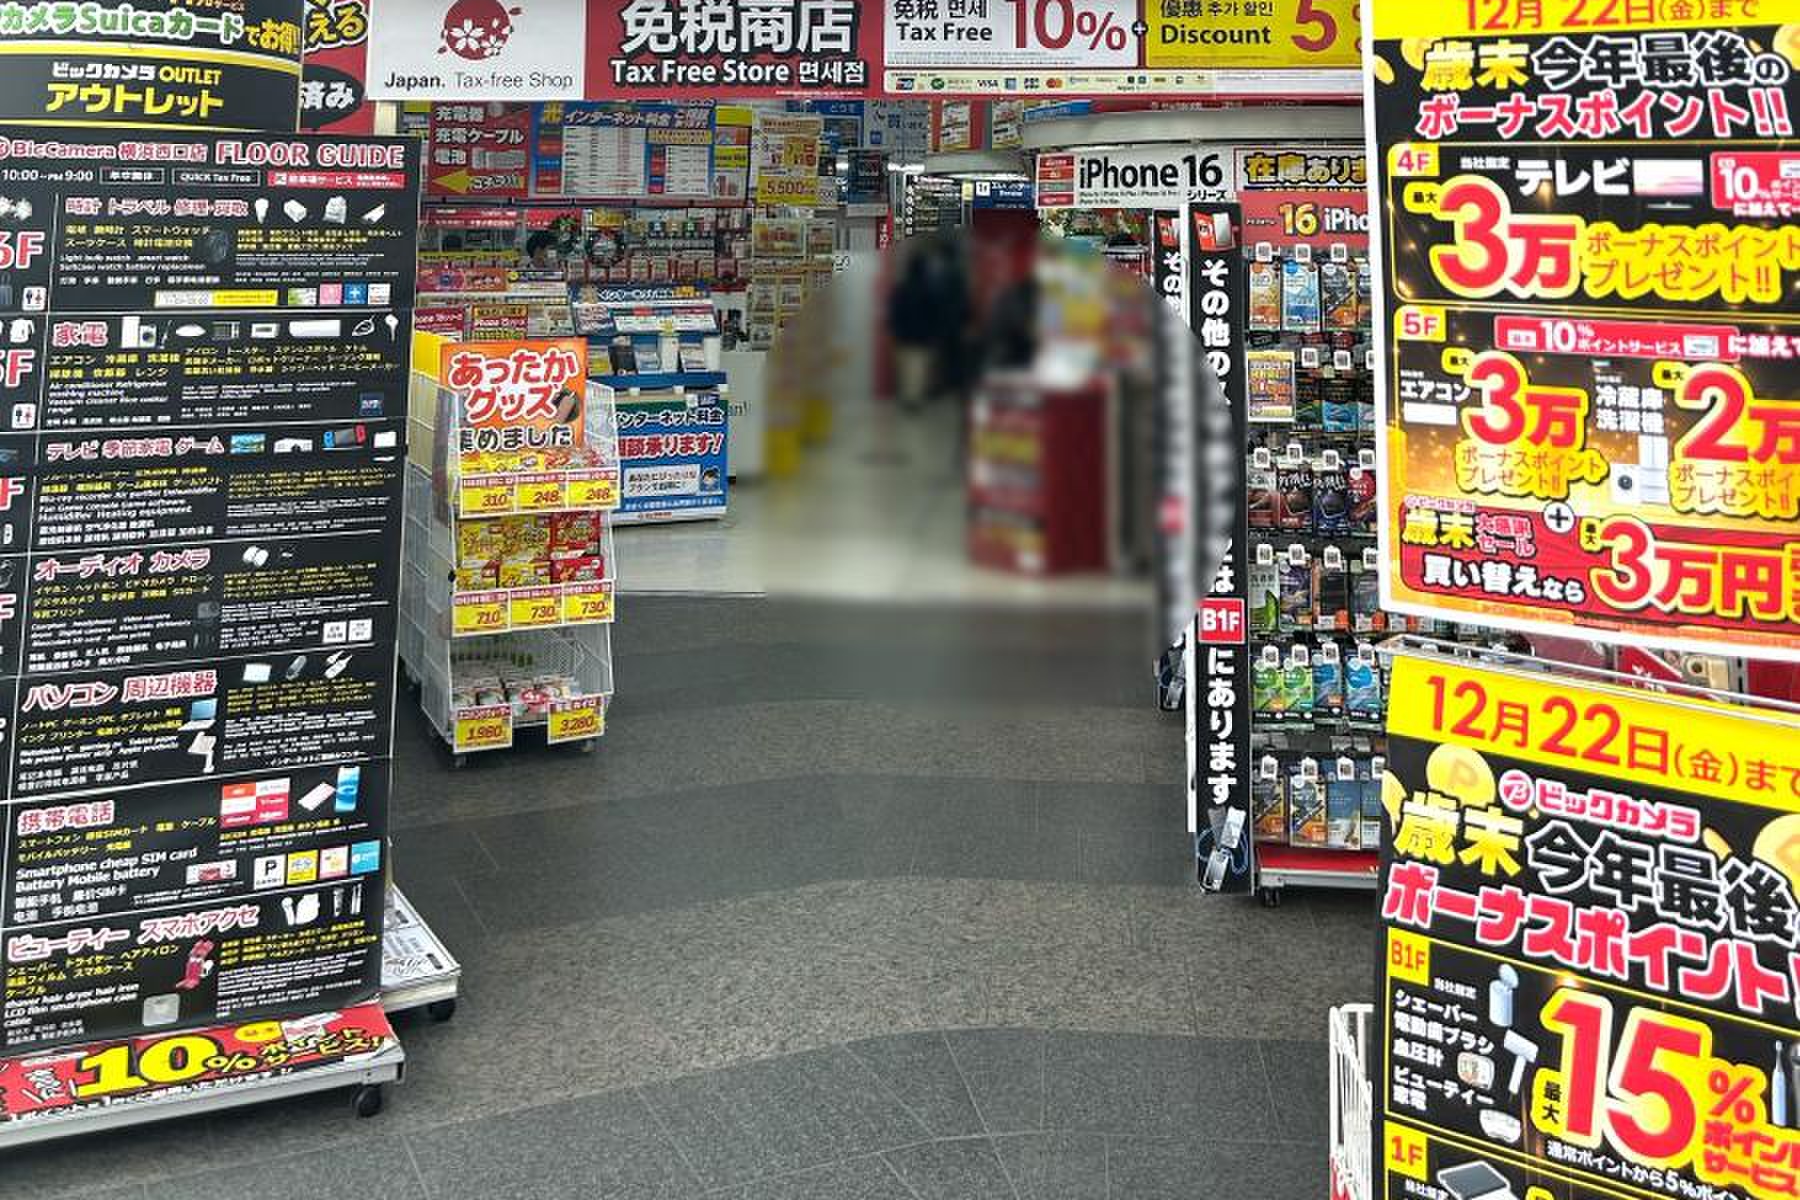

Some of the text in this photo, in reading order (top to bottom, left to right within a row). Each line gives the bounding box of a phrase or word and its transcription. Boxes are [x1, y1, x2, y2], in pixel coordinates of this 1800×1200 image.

[946, 0, 989, 20] 면세
[896, 22, 994, 43] Tax Free
[1160, 23, 1272, 47] Discount
[52, 62, 223, 85] ビックカメラ OUTLET
[611, 58, 655, 83] Tax
[661, 58, 718, 82] Free
[722, 57, 789, 83] Store
[798, 59, 866, 85] 면세점
[1533, 32, 1790, 89] 今年最後の
[384, 71, 574, 93] Japan. Tax-free Shop
[46, 84, 225, 118] アウトレット
[1416, 88, 1793, 139] ボーナスポイント!!
[435, 128, 525, 145] 充電ケーブル
[216, 141, 310, 167] FLOOR
[317, 144, 405, 168] GUIDE
[1396, 149, 1432, 172] 4F
[1079, 154, 1224, 190] iPhone 16
[1515, 159, 1631, 197] テレビ
[1187, 189, 1228, 200] シリーズ
[1279, 203, 1369, 235] 16 iPho
[1438, 182, 1577, 292] 3万
[1592, 262, 1772, 294] プレゼント!!
[52, 321, 109, 348] 家電
[1402, 312, 1439, 336] 5F
[450, 350, 578, 386] あったか
[466, 387, 557, 422] グッズ
[1400, 380, 1472, 401] エアコン
[1470, 357, 1582, 446] 3万
[46, 435, 225, 462] テレビ ゲーム
[1401, 508, 1476, 549] 歳末
[33, 547, 211, 582] オーディオ カメラ
[1422, 554, 1587, 603] 買い替えなら
[1202, 608, 1241, 633] B1F
[20, 680, 119, 713] パソコン
[1206, 647, 1238, 806] にあります
[1535, 777, 1701, 843] ビックカメラ
[1394, 792, 1525, 878] 歳末
[16, 860, 98, 881] Smartphone
[7, 905, 260, 964] ビューティー スマホアクセ
[1395, 988, 1478, 1022] シェーバー
[1394, 1064, 1494, 1105] ビューティー
[1541, 1080, 1562, 1125] 最大
[1391, 1135, 1423, 1167] 1F
